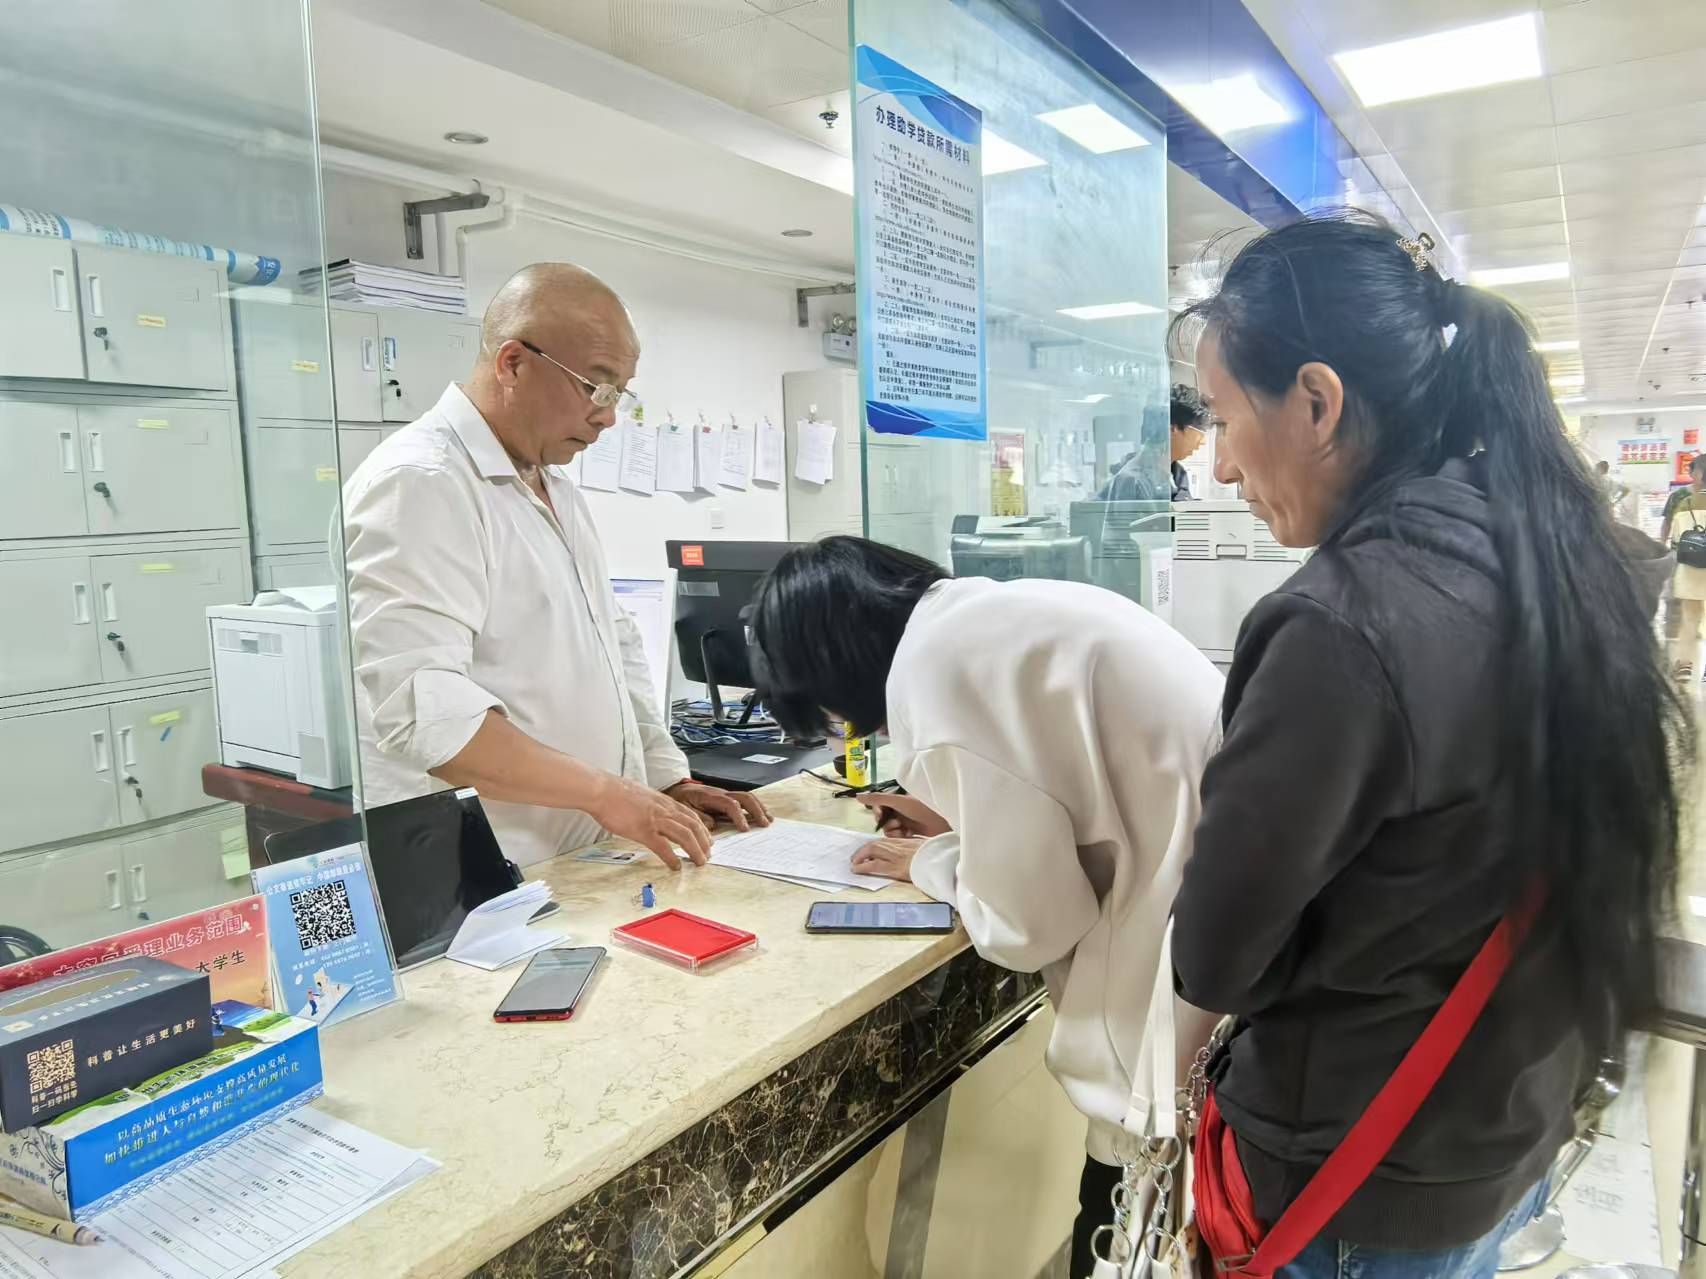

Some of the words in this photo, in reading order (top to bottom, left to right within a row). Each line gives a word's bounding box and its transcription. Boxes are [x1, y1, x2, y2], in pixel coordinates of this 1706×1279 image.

[876, 105, 970, 166] 办理助学贷款所需材料
[195, 949, 247, 974] 大学生
[87, 1018, 197, 1068] 科普让生活更美好
